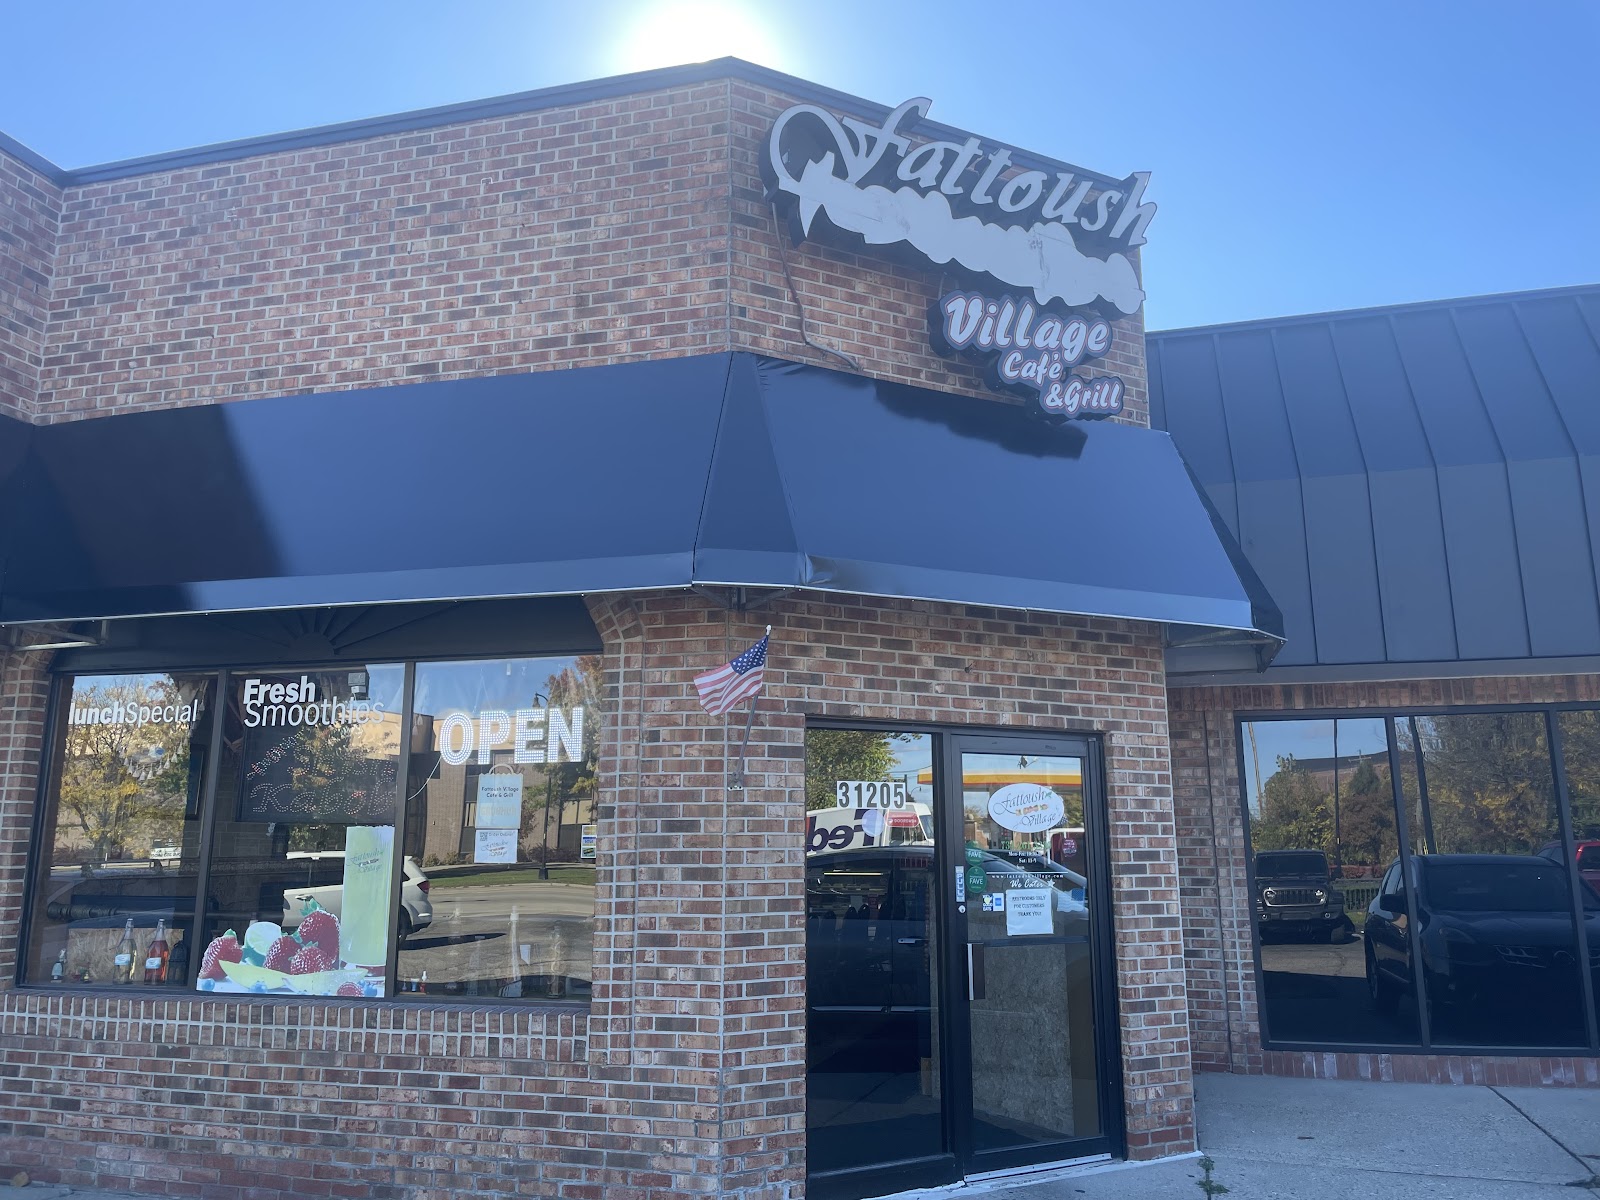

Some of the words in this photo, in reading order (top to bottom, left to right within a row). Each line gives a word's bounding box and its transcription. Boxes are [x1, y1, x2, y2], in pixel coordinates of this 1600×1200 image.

[769, 97, 1158, 247] Fattoush
[945, 295, 1108, 362] Village
[1003, 352, 1063, 386] Café
[243, 676, 316, 704] Fresh
[244, 696, 385, 727] Smoothies
[439, 707, 583, 765] OPEN
[838, 782, 904, 809] 31205
[993, 787, 1045, 815] Fattoush
[1018, 812, 1056, 828] Village
[968, 850, 983, 858] FAVE
[956, 873, 965, 896] PULL
[1010, 879, 1022, 888] We
